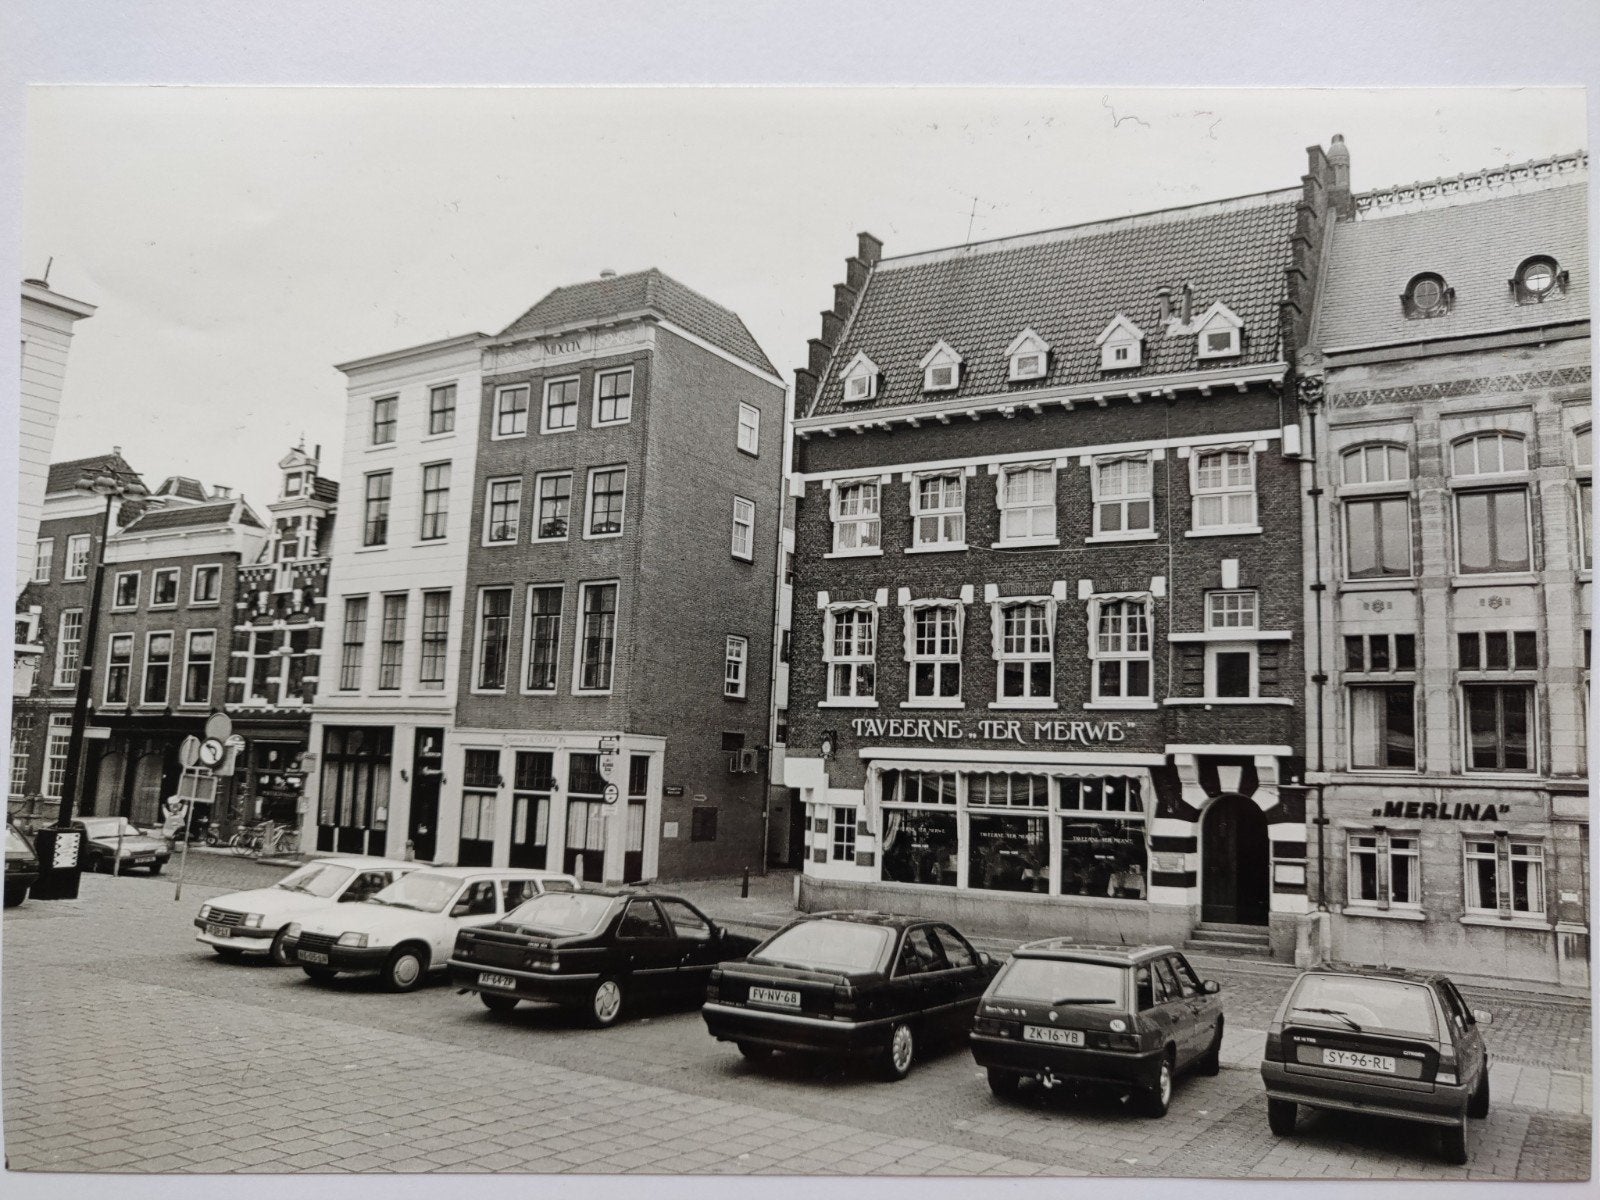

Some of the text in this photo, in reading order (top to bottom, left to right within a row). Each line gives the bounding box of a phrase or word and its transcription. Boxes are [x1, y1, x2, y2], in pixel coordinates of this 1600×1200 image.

[851, 718, 964, 743] TAVEERNE
[752, 988, 797, 1004] FV-NV-68
[1029, 1027, 1078, 1044] ZK-16-YB
[1328, 1051, 1390, 1070] SY-96-RL
